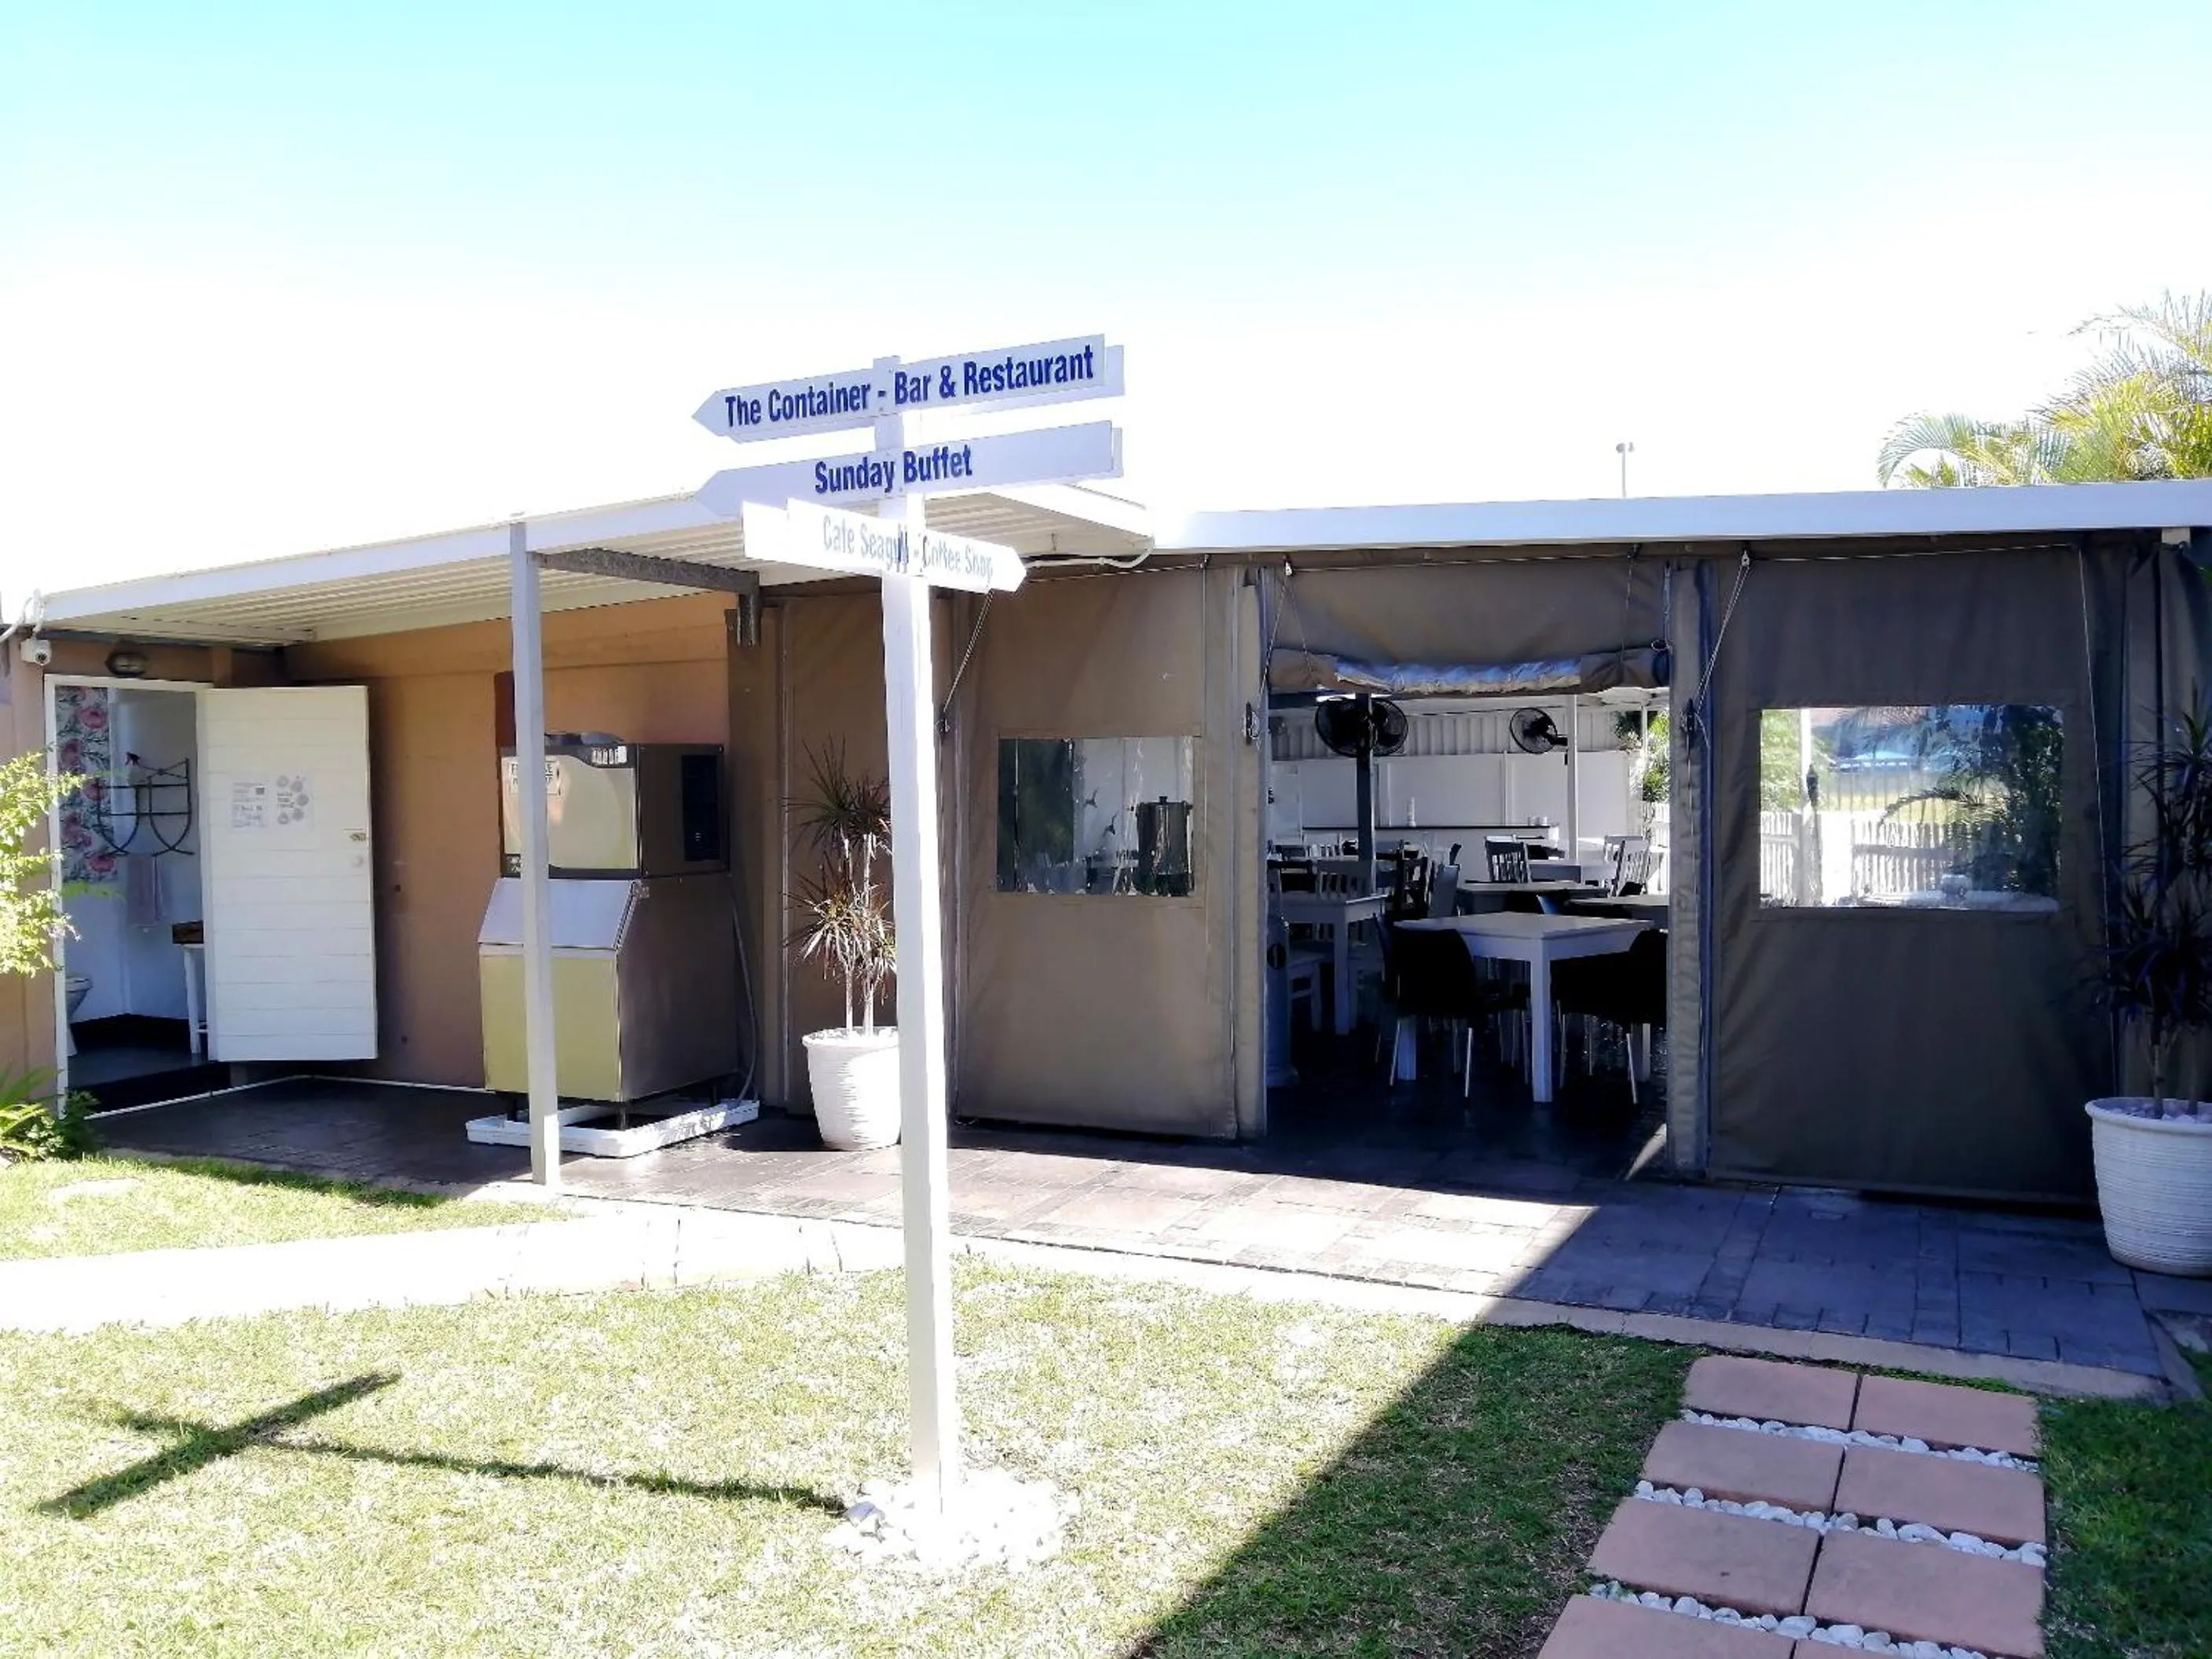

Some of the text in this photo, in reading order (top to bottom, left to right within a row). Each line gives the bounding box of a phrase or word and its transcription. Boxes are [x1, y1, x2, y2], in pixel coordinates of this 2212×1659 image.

[725, 395, 761, 427] The
[767, 382, 871, 422] Container
[894, 371, 932, 405] Bar
[939, 364, 956, 399] &
[963, 344, 1093, 396] Restaurant
[815, 445, 972, 493] Sunday Buffet
[823, 515, 855, 554] Cafe
[922, 534, 961, 572] Coffee
[965, 545, 993, 580] Shop
